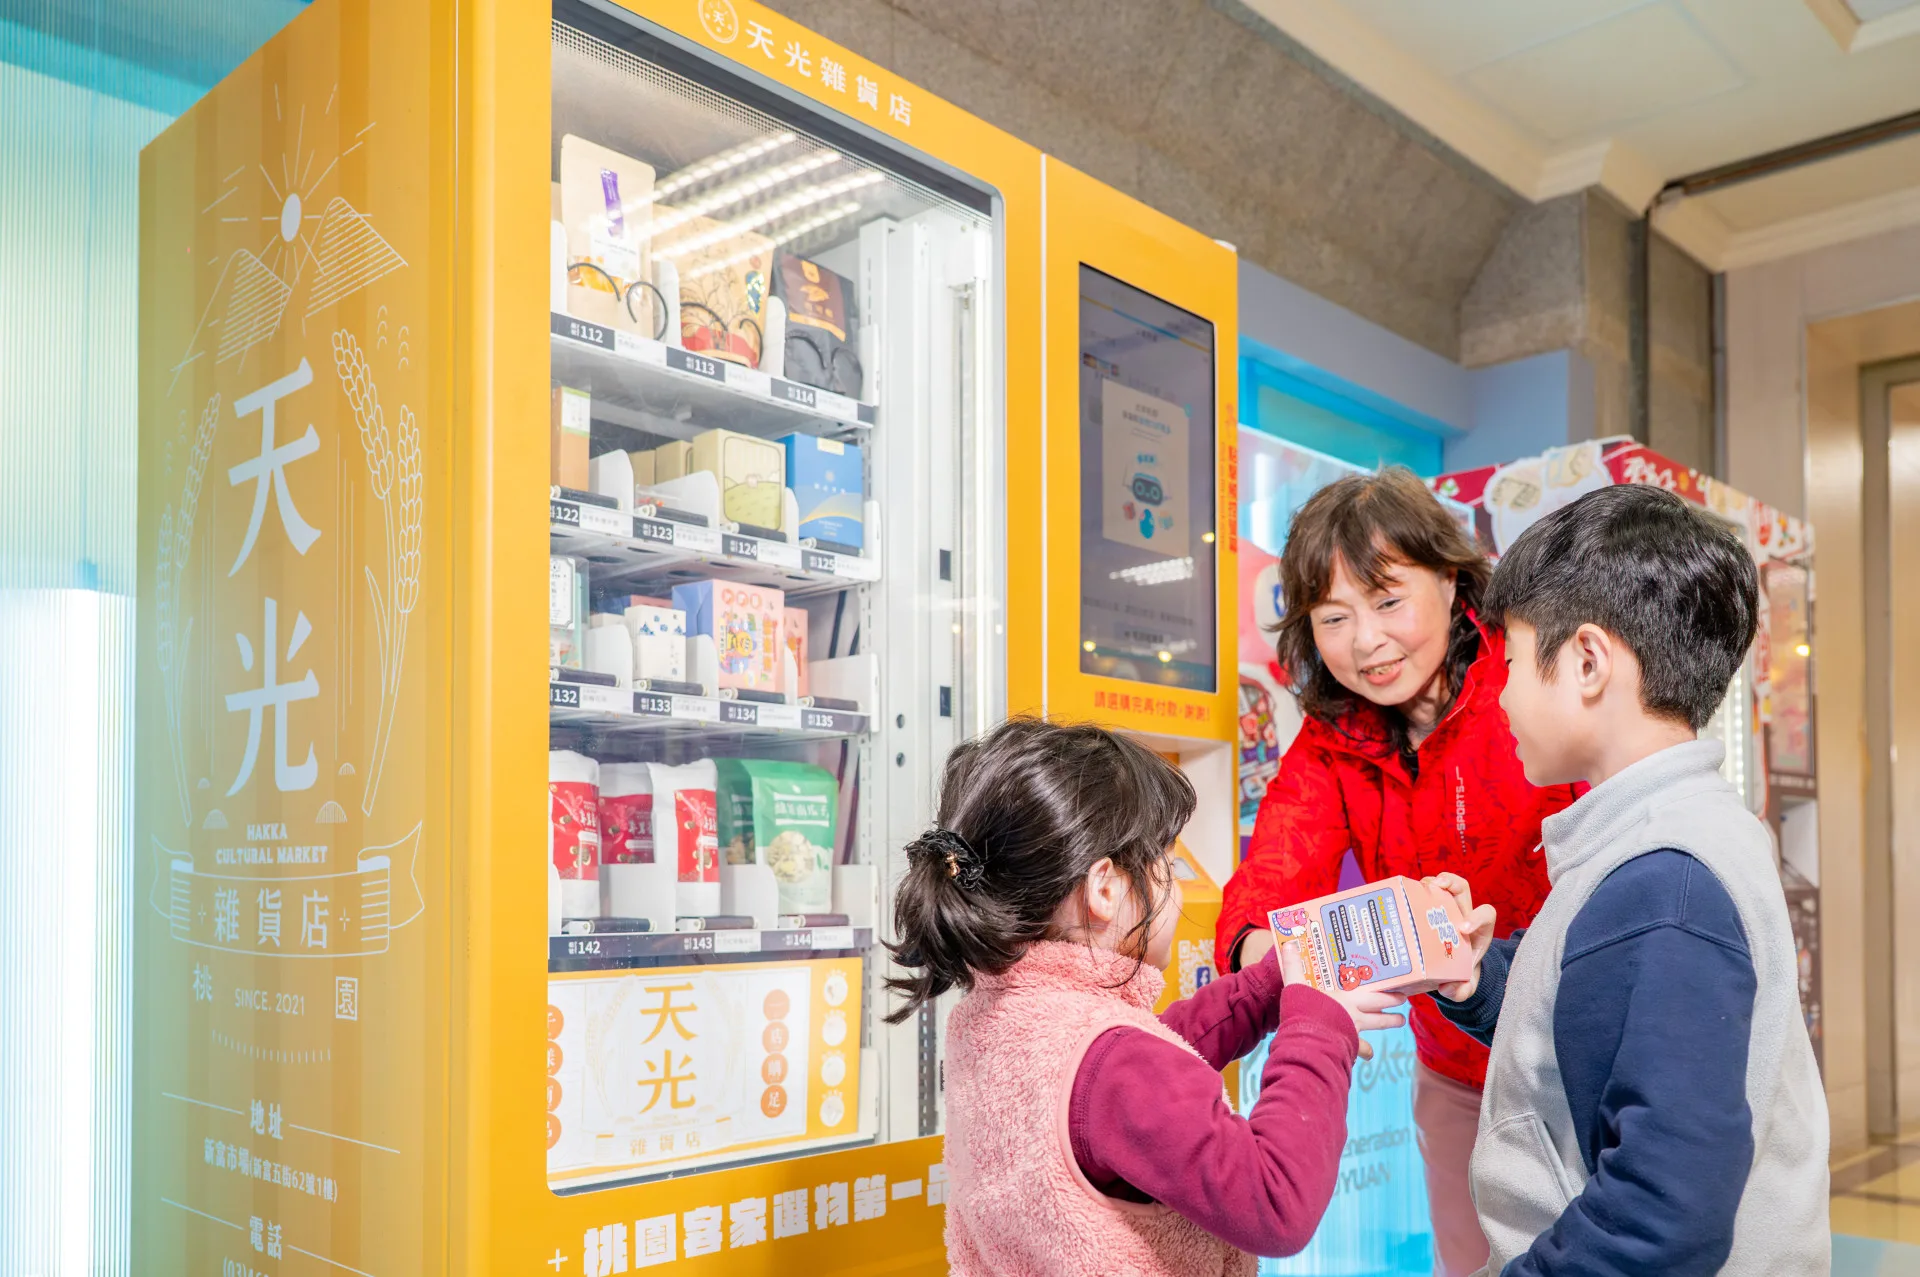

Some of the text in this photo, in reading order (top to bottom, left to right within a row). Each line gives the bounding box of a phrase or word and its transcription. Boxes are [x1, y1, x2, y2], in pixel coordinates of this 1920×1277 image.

[745, 19, 912, 127] 天光雜貨店
[580, 325, 603, 343] 112
[695, 358, 715, 376] 113
[796, 387, 814, 405] 114
[556, 506, 579, 523] 122
[652, 525, 673, 541] 123
[738, 541, 757, 557] 124
[817, 557, 835, 571] 125
[224, 357, 321, 796] 天光
[554, 688, 577, 704] 132
[650, 699, 671, 713] 133
[736, 707, 756, 721] 134
[815, 714, 833, 728] 135
[1455, 785, 1466, 831] SPORTS
[246, 823, 288, 841] HAKKA
[215, 845, 328, 866] CULTURAL MARKET
[213, 885, 330, 950] 雜貨店
[578, 940, 601, 955] 142
[692, 937, 712, 950] 143
[794, 934, 812, 947] 144
[193, 963, 213, 1003] 桃
[275, 993, 306, 1017] 2021
[336, 976, 358, 1022] 園
[637, 981, 698, 1115] 天光
[249, 1099, 284, 1141] 地址
[1336, 1160, 1391, 1196] YUAN
[249, 1215, 283, 1262] 電話
